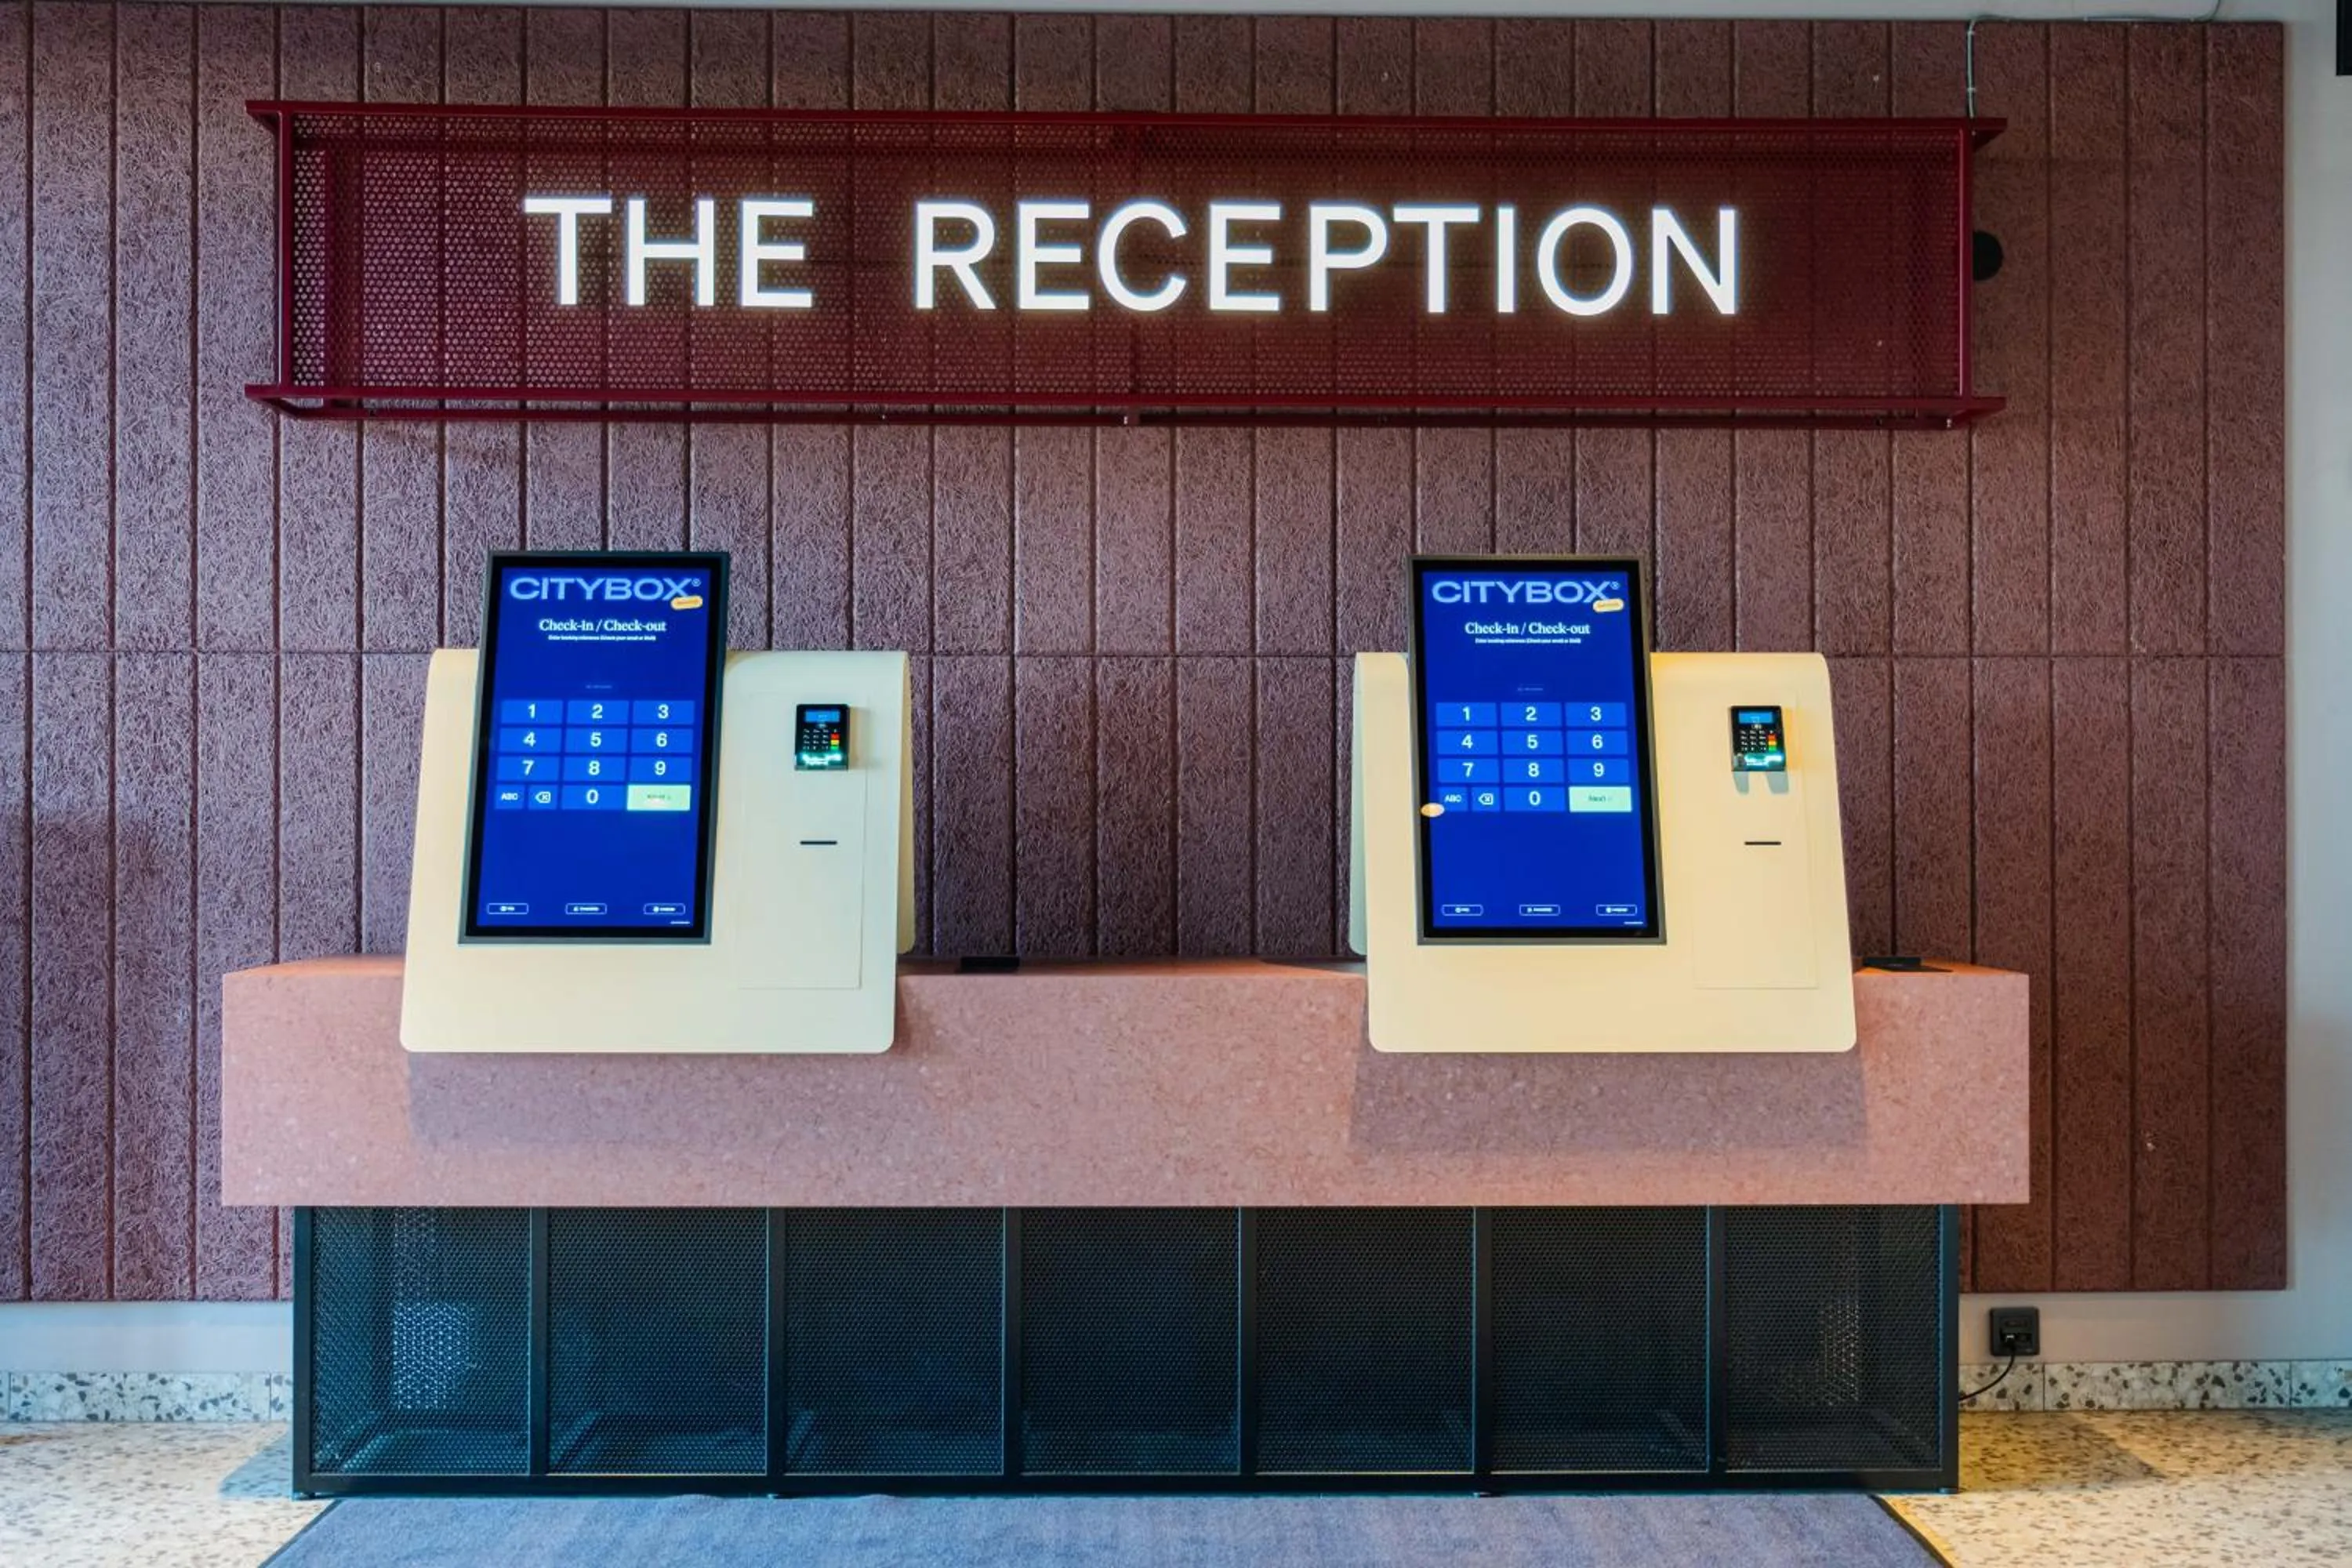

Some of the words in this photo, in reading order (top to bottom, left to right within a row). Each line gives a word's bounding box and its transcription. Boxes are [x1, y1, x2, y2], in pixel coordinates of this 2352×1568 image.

[523, 196, 814, 309] THE
[914, 201, 1737, 318] RECEPTION
[510, 577, 692, 601] CITYBOX
[1432, 580, 1610, 604] CITYBOX
[539, 618, 594, 632] Check-in
[603, 619, 667, 632] Check-out
[1465, 621, 1519, 634] Check-in
[1528, 621, 1591, 634] Check-out
[528, 702, 536, 719] 1
[591, 702, 603, 720] 2
[657, 702, 669, 720] 3
[1461, 706, 1471, 722] 1
[1526, 706, 1537, 722] 2
[1590, 706, 1602, 722] 3
[522, 731, 536, 748] 4
[590, 731, 601, 747] 5
[655, 731, 667, 748] 6
[1461, 734, 1474, 750] 4
[1527, 734, 1538, 750] 5
[1592, 734, 1603, 750] 6
[522, 760, 535, 776] 7
[588, 760, 601, 776] 8
[654, 760, 666, 776] 9
[1462, 762, 1474, 778] 7
[1528, 762, 1540, 778] 8
[1592, 762, 1605, 778] 9
[586, 788, 600, 804] 0
[1528, 790, 1541, 807] 0
